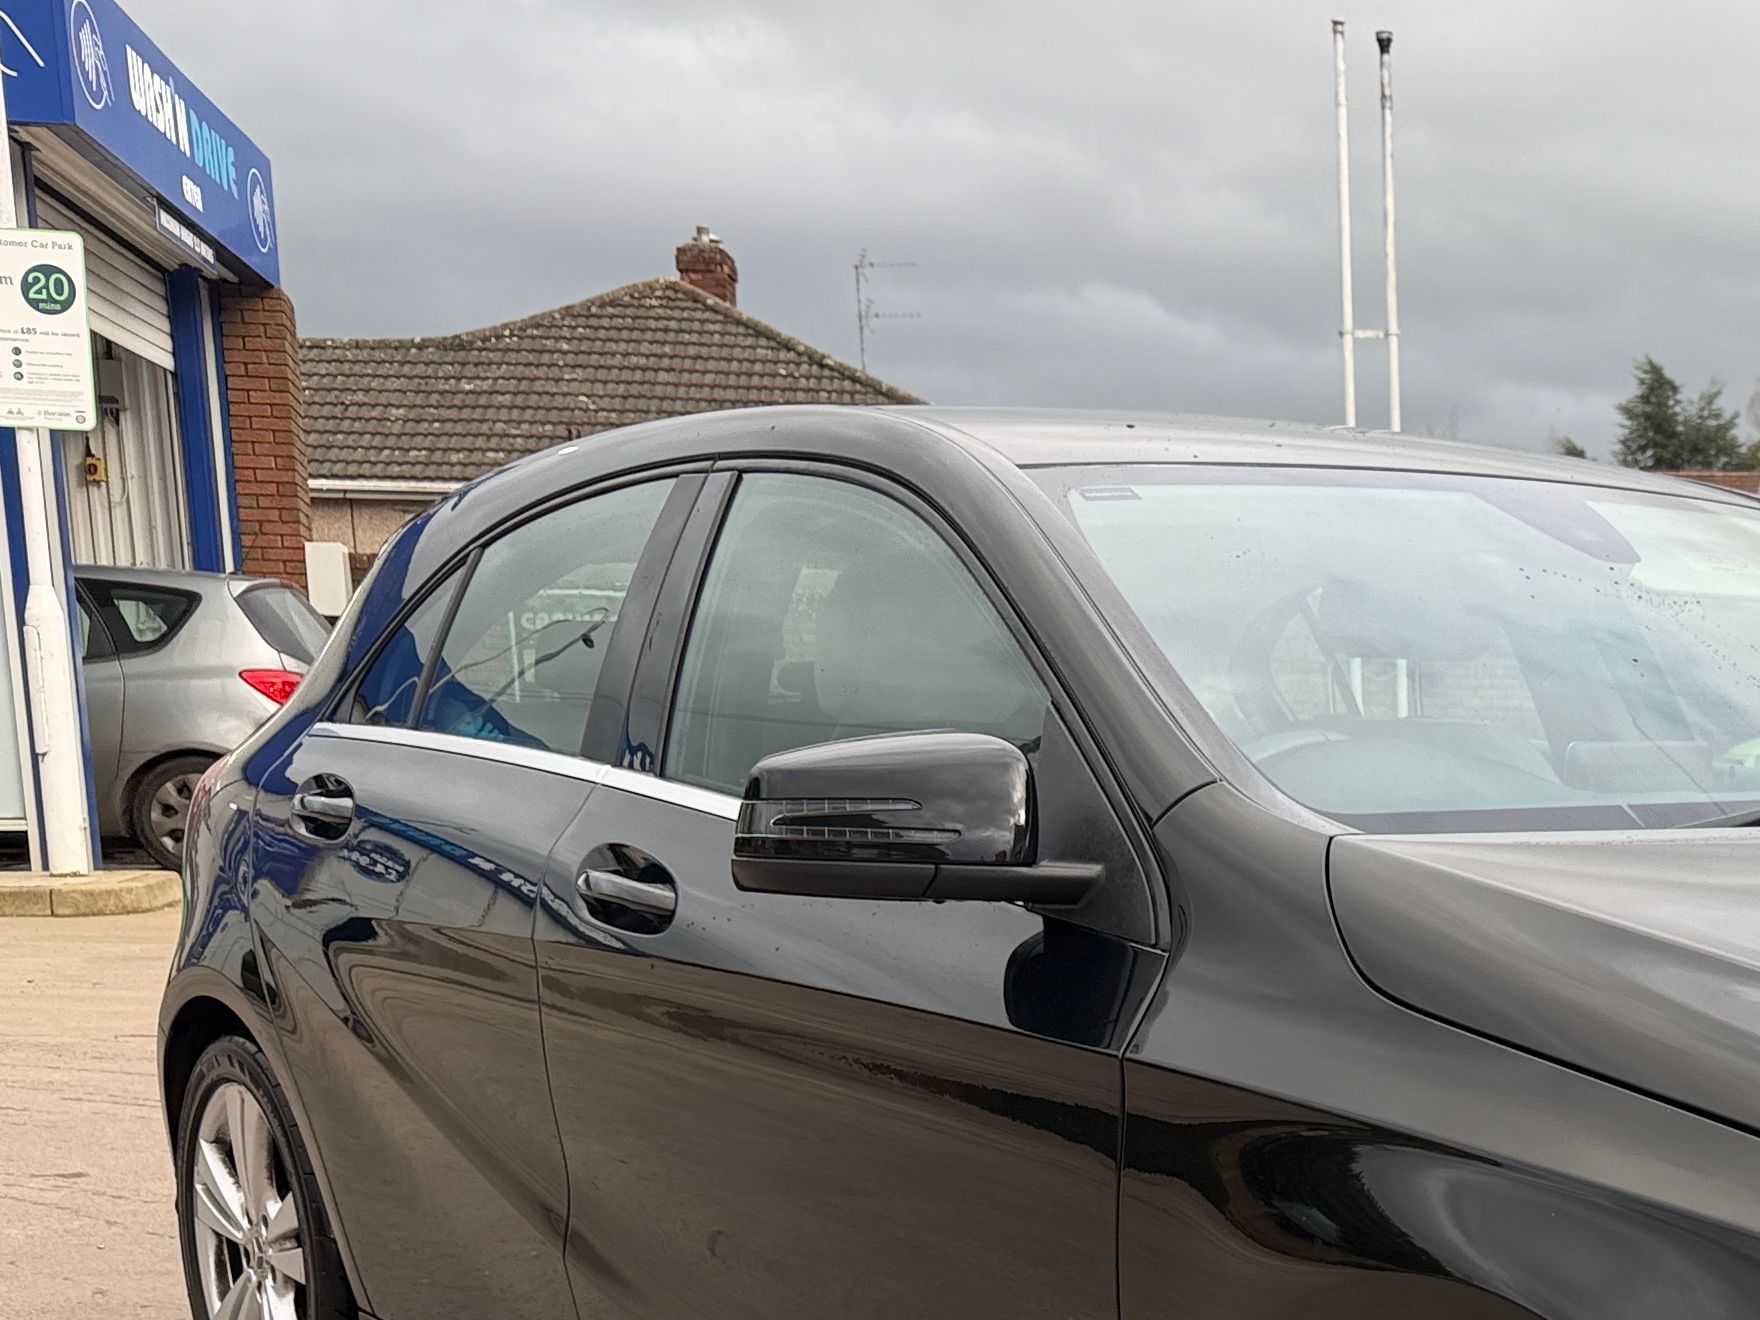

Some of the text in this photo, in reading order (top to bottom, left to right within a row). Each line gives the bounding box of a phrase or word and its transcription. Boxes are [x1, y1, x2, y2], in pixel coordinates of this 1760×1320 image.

[30, 239, 49, 249] Car
[51, 240, 74, 250] Park
[27, 271, 70, 301] 20
[20, 326, 38, 335] £85
